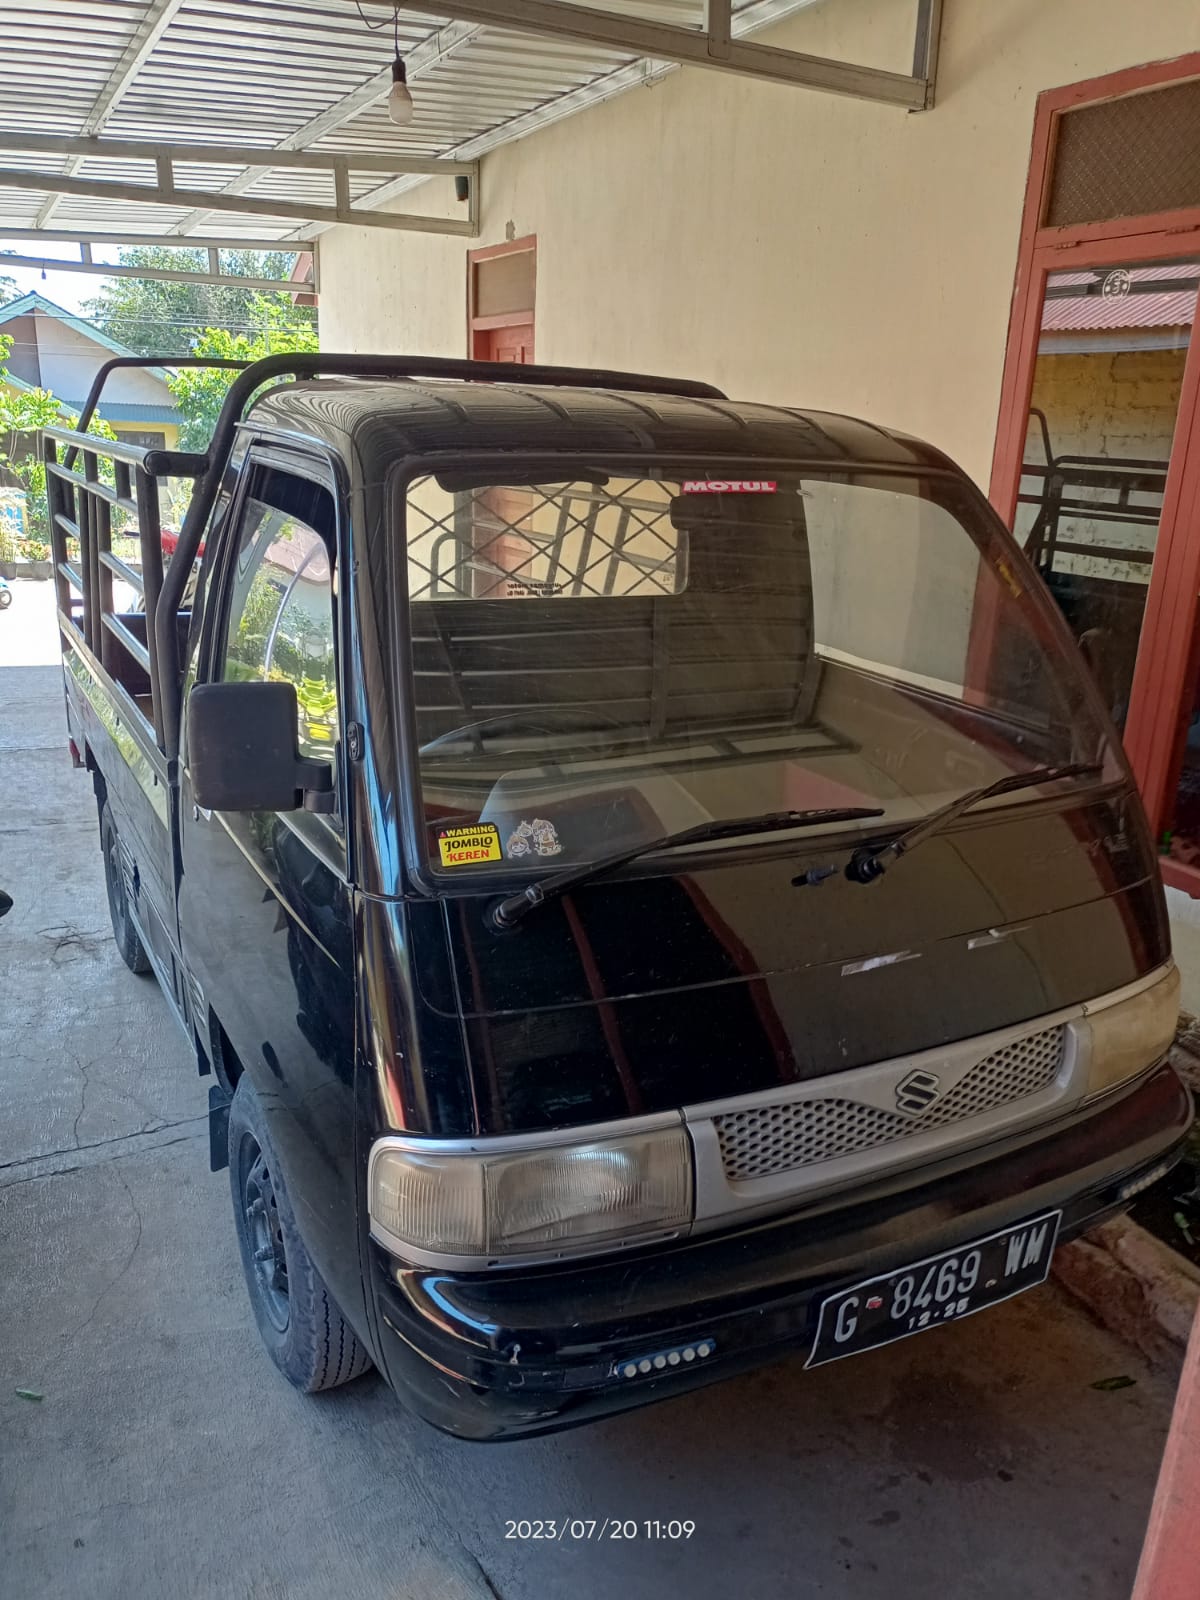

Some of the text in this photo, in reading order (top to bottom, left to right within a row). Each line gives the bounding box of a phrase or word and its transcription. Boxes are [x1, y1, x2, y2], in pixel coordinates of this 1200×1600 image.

[683, 481, 775, 491] MOTUL
[446, 825, 495, 837] WARNING
[444, 836, 493, 852] JOMBLO
[447, 849, 490, 862] KEREN
[834, 1296, 859, 1342] G
[890, 1250, 981, 1319] 8469
